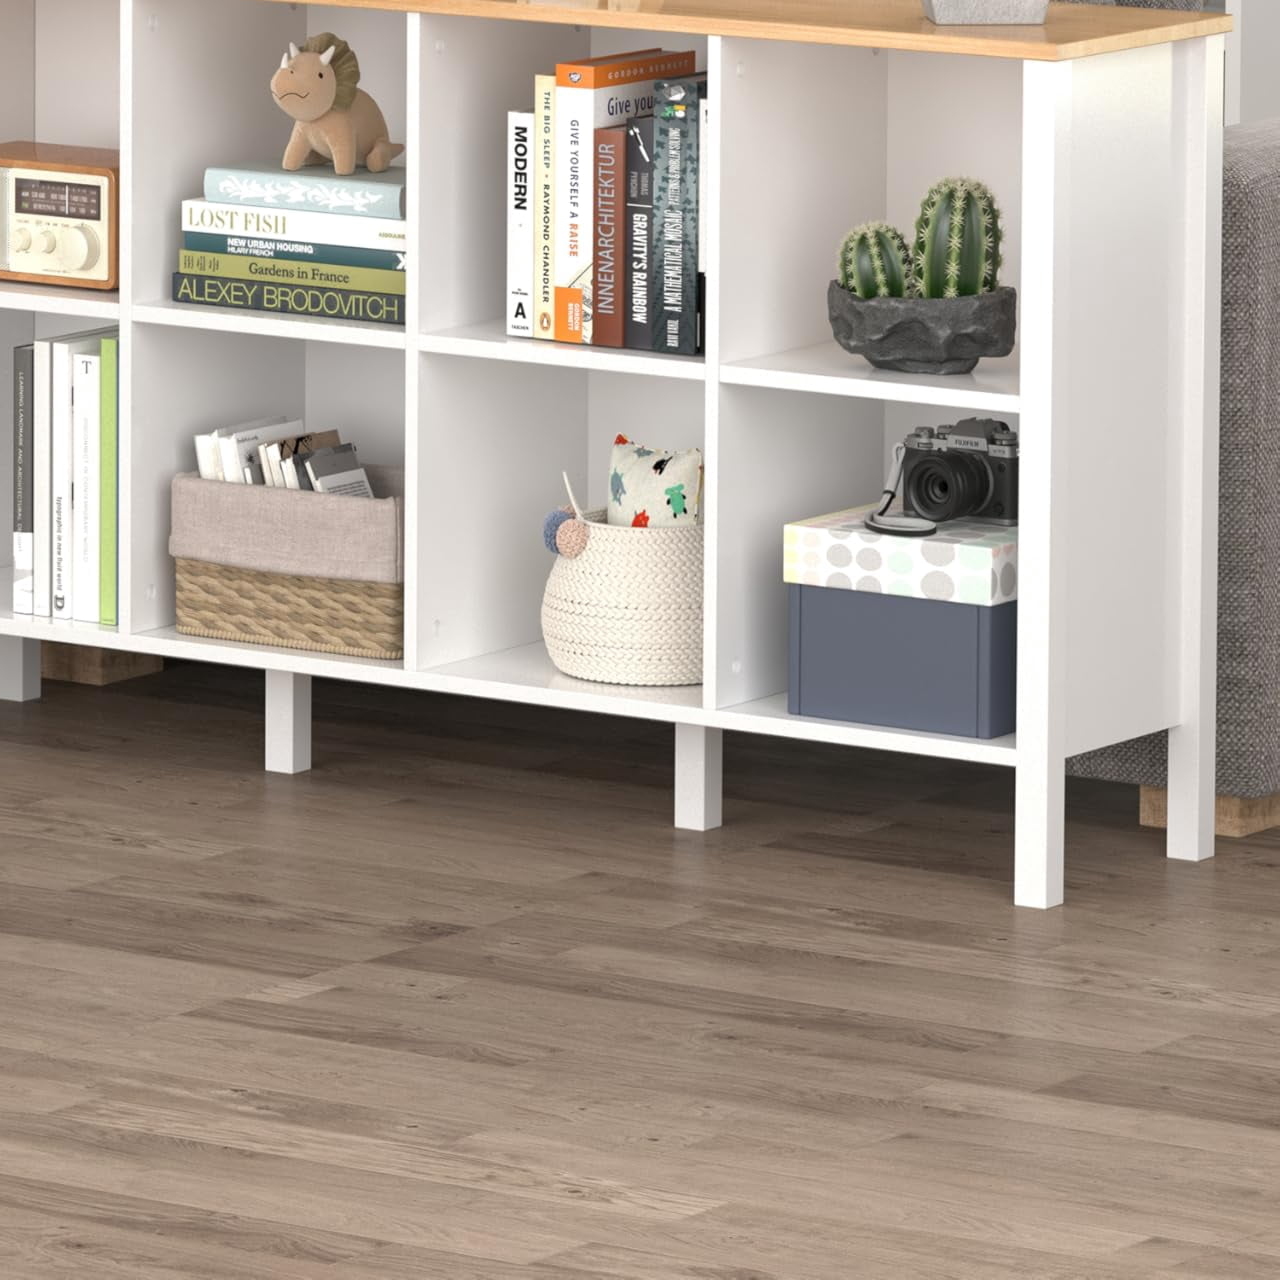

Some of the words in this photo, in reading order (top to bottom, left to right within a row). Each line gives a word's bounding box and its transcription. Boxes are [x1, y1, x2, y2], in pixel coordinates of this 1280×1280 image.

[543, 91, 551, 111] THE
[607, 97, 631, 116] Give
[543, 115, 551, 134] BIG
[569, 119, 580, 146] GIVE
[514, 125, 528, 210] MODERN
[543, 138, 551, 169] SLEEP
[569, 150, 580, 207] YOURSELF
[188, 207, 238, 229] LOST
[244, 212, 287, 235] FISH
[542, 183, 550, 240] RAYMOND
[569, 211, 579, 219] A
[663, 209, 683, 242] MOSAIC
[569, 223, 579, 257] RAISE
[597, 143, 615, 315] INNENARCHITEKTUR
[632, 213, 648, 271] GRAVITY'S
[227, 237, 246, 247] NEW
[247, 239, 275, 250] URBAN
[276, 242, 314, 255] HOUSING
[248, 262, 295, 279] Gardens
[297, 265, 308, 279] in
[311, 268, 350, 284] France
[542, 245, 550, 303] CHANDLER
[663, 243, 682, 305] MATHEMATICAL
[177, 278, 258, 306] ALEXEY
[263, 286, 399, 321] BRODOVITCH
[514, 302, 526, 319] A
[631, 271, 648, 324] RAINBOW
[81, 360, 92, 375] T
